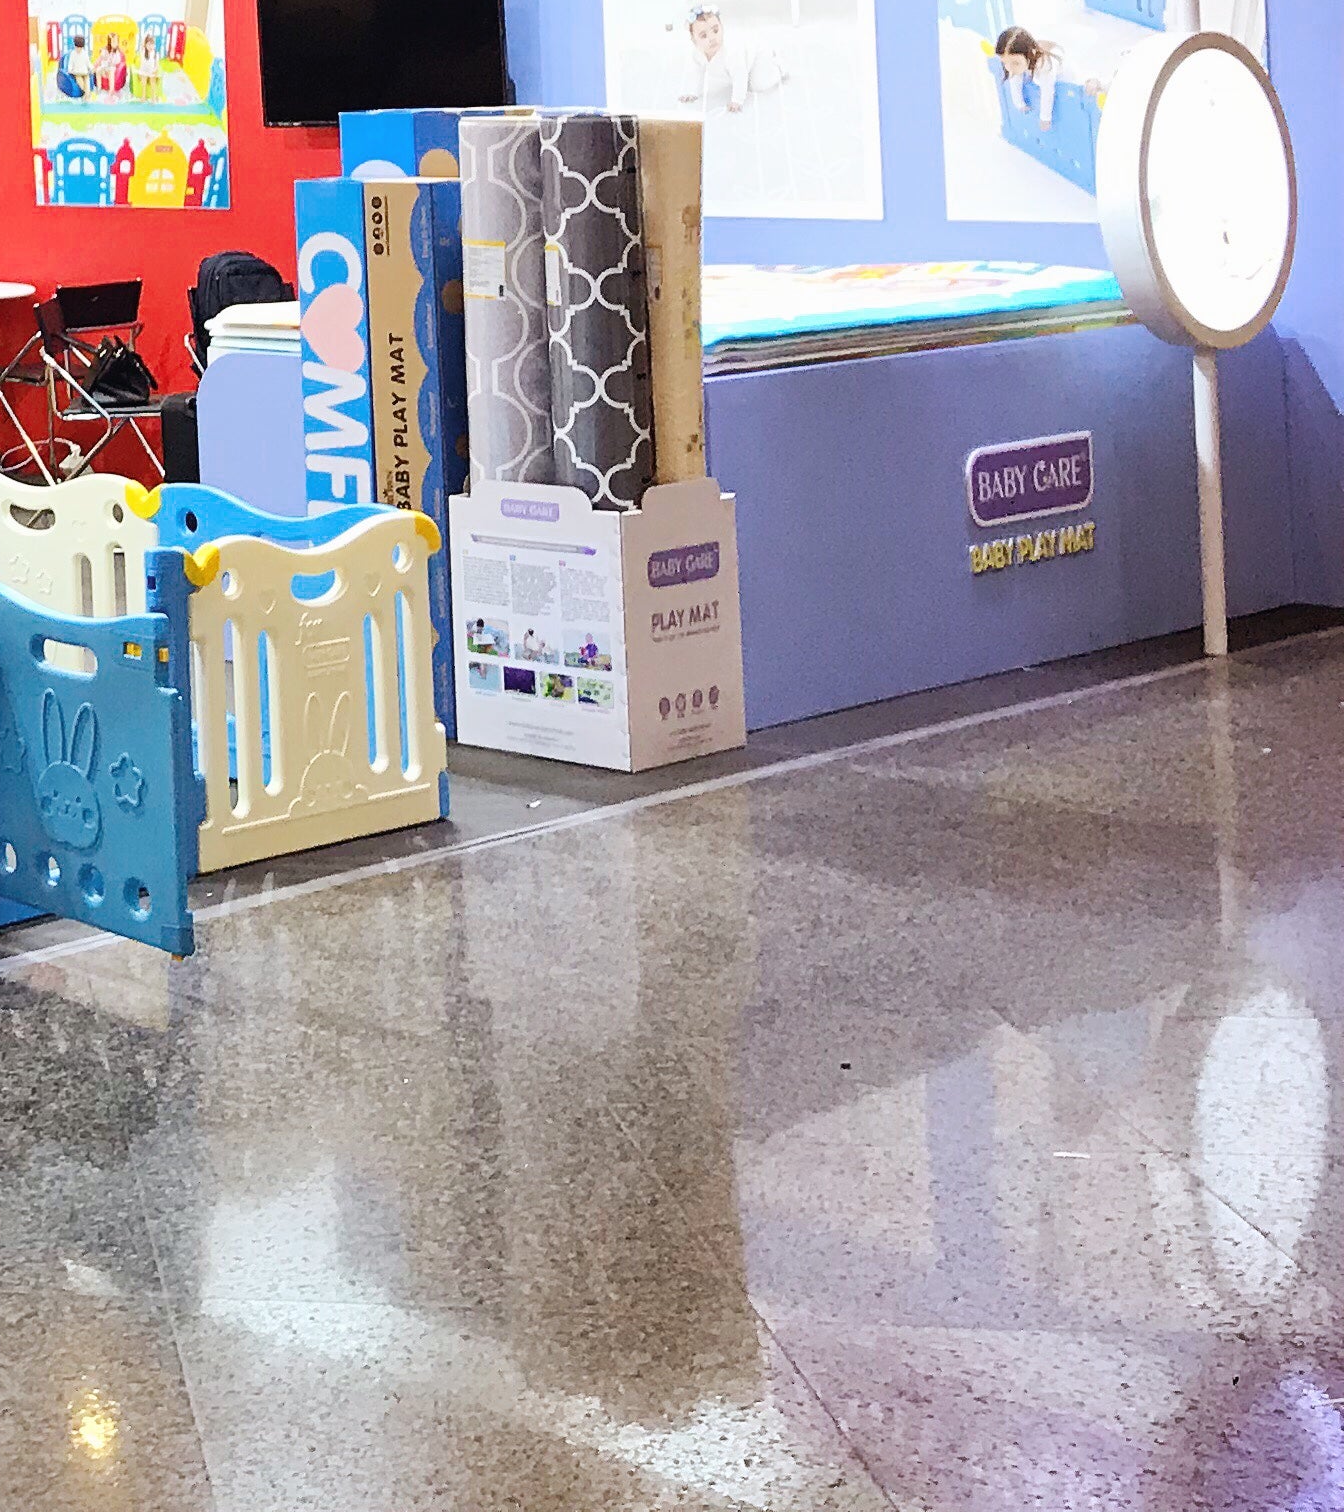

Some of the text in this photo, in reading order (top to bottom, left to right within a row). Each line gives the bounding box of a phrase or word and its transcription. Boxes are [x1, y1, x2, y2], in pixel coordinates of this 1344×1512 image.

[389, 332, 407, 386] MAT
[392, 396, 409, 448] PLAY
[978, 454, 1082, 502] BABY CARE
[651, 558, 682, 579] BABY
[969, 521, 1096, 574] BABY PLAY MAT
[651, 600, 720, 633] PLAY MAT
